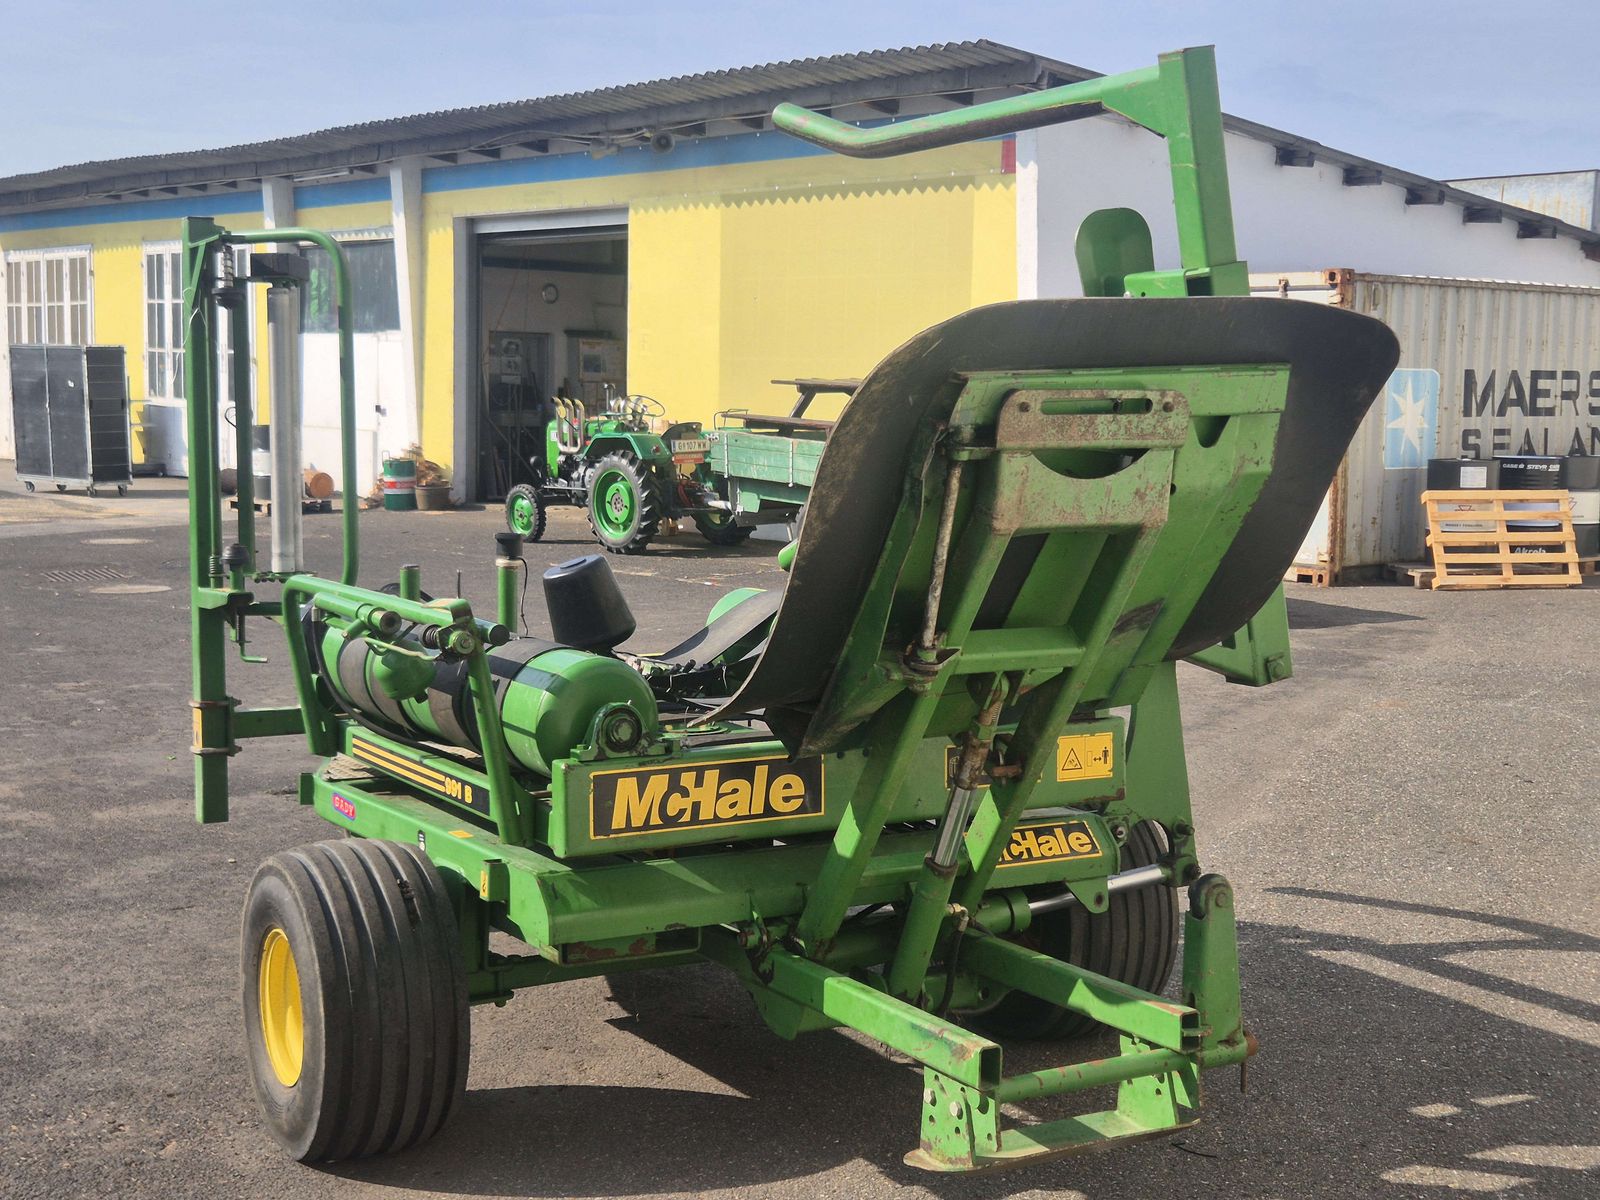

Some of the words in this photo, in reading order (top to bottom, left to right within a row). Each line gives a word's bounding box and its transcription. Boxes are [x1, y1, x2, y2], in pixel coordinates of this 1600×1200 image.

[445, 777, 462, 800] 991
[464, 785, 473, 804] B
[611, 765, 805, 830] McHale
[334, 796, 354, 817] GADY
